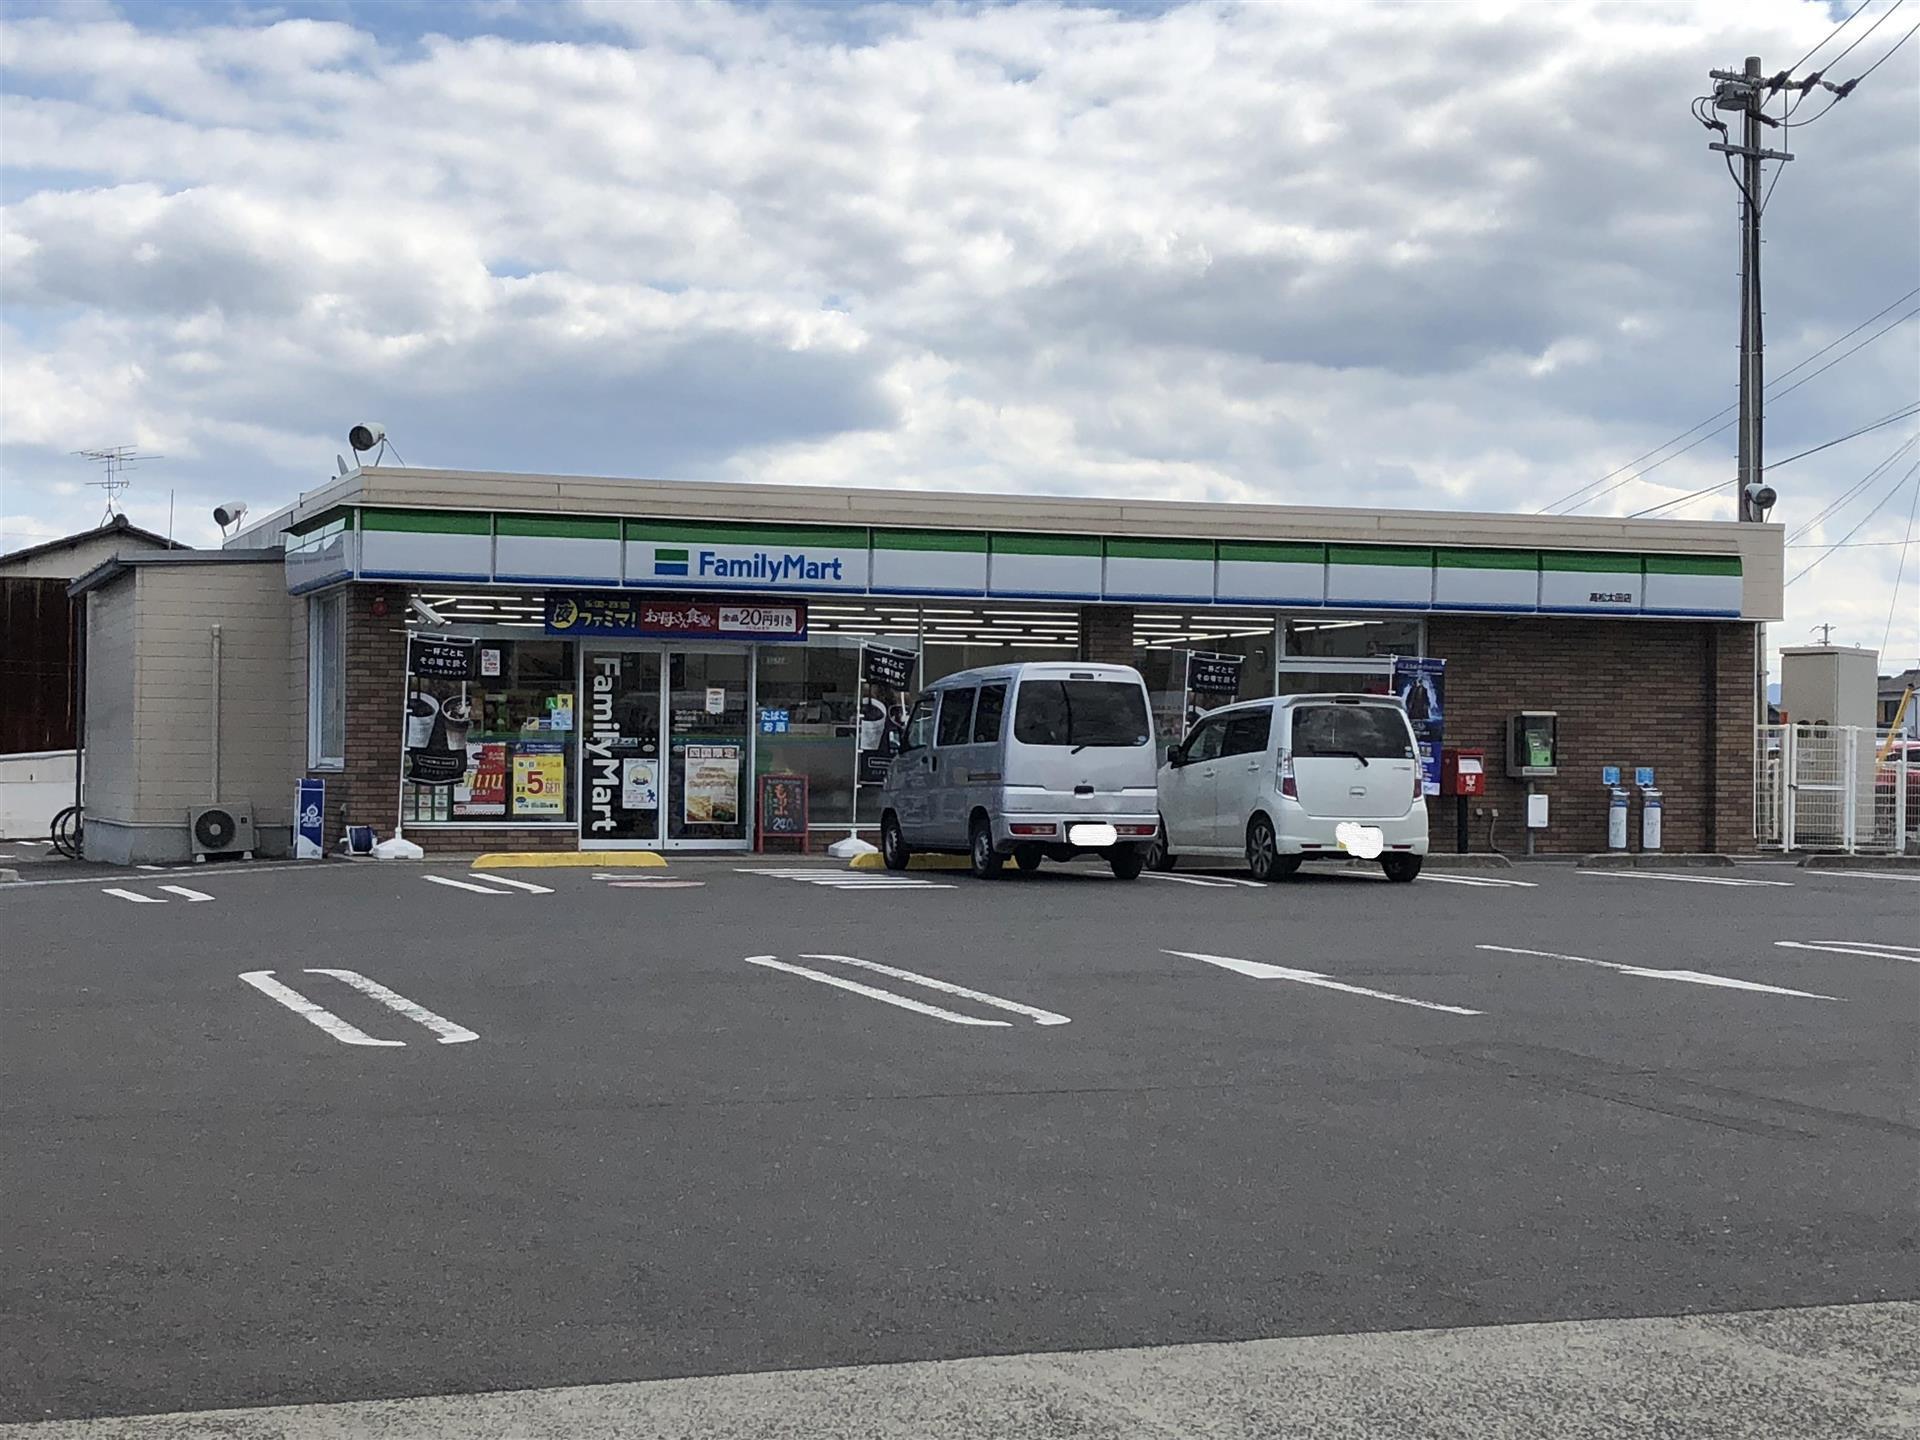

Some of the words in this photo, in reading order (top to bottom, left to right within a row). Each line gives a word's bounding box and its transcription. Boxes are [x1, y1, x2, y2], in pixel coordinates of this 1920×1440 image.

[699, 551, 843, 582] FamilyMart
[1589, 592, 1632, 604] 高松太田店
[644, 607, 711, 628] お母さん食堂
[760, 711, 789, 722] たばこ
[763, 721, 788, 733] お酒
[585, 656, 622, 832] FamilyMart
[526, 770, 545, 795] 5
